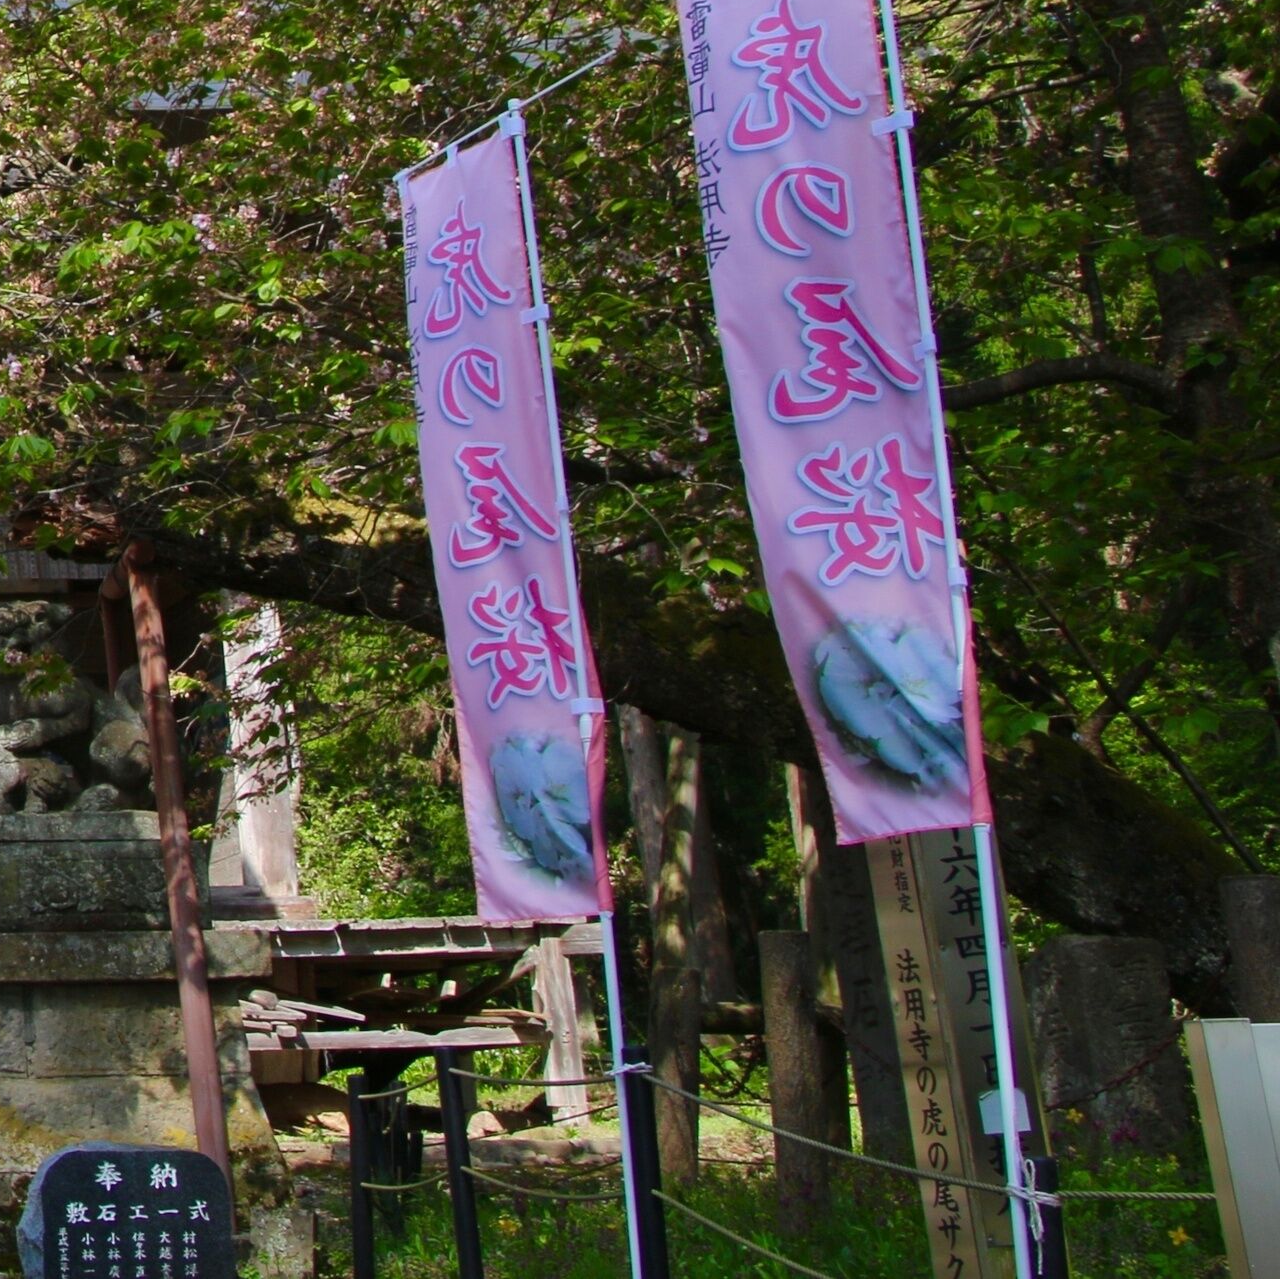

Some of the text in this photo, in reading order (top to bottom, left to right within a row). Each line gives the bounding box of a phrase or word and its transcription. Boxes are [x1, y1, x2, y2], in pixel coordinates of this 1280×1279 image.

[95, 1160, 178, 1191] 奉納
[66, 1200, 210, 1224] 敷石工一式
